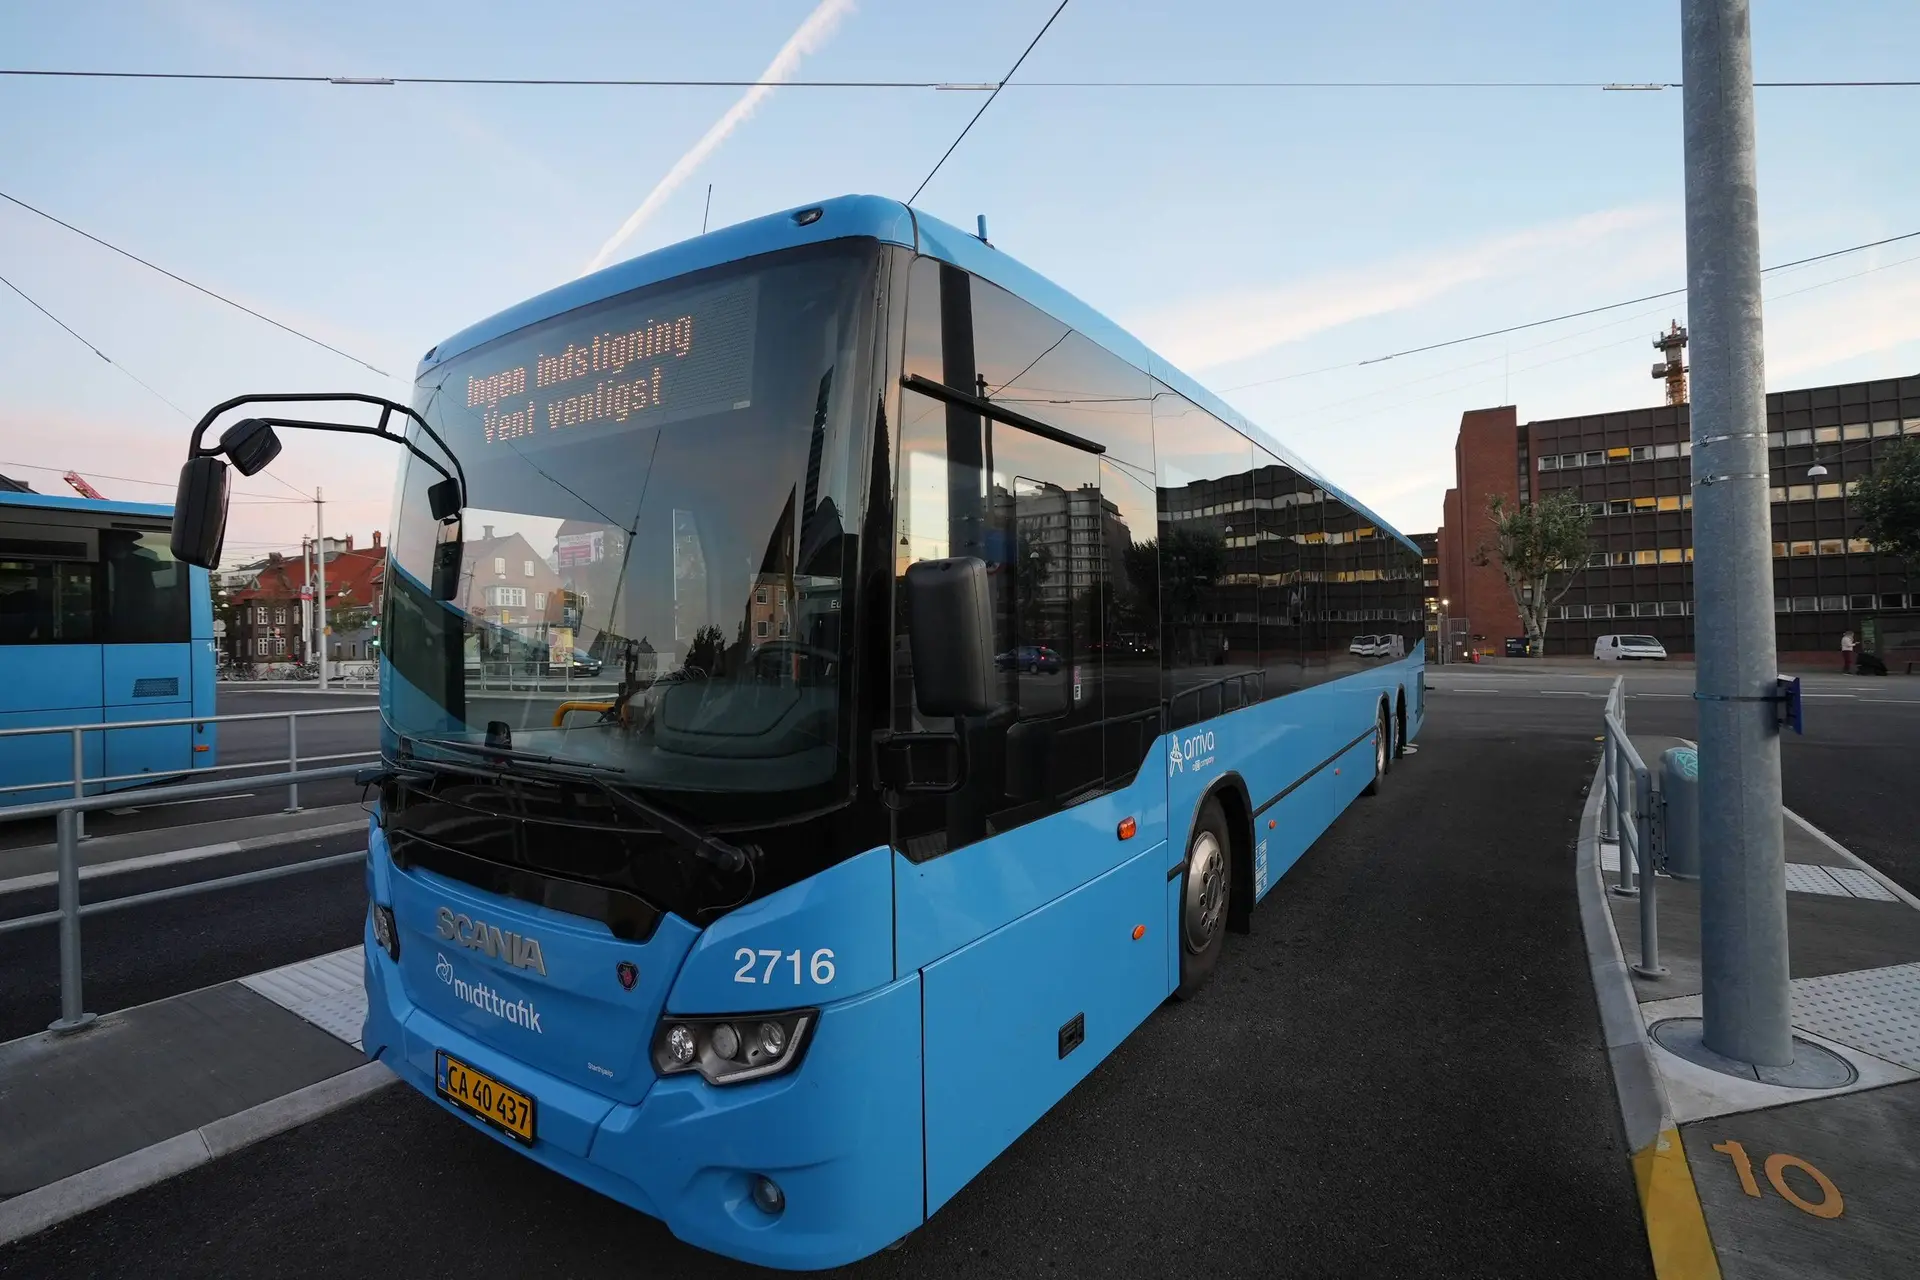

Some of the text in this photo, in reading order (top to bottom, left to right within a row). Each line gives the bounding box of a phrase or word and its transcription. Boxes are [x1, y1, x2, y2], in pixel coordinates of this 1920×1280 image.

[536, 315, 693, 388] indstigning
[483, 367, 662, 444] Vent venligst
[1184, 728, 1215, 761] arriva
[436, 906, 547, 976] SCANIA
[734, 947, 836, 985] 2716
[454, 978, 543, 1034] midttrafik
[448, 1065, 528, 1130] CA 40 437
[1711, 1139, 1844, 1219] 10
